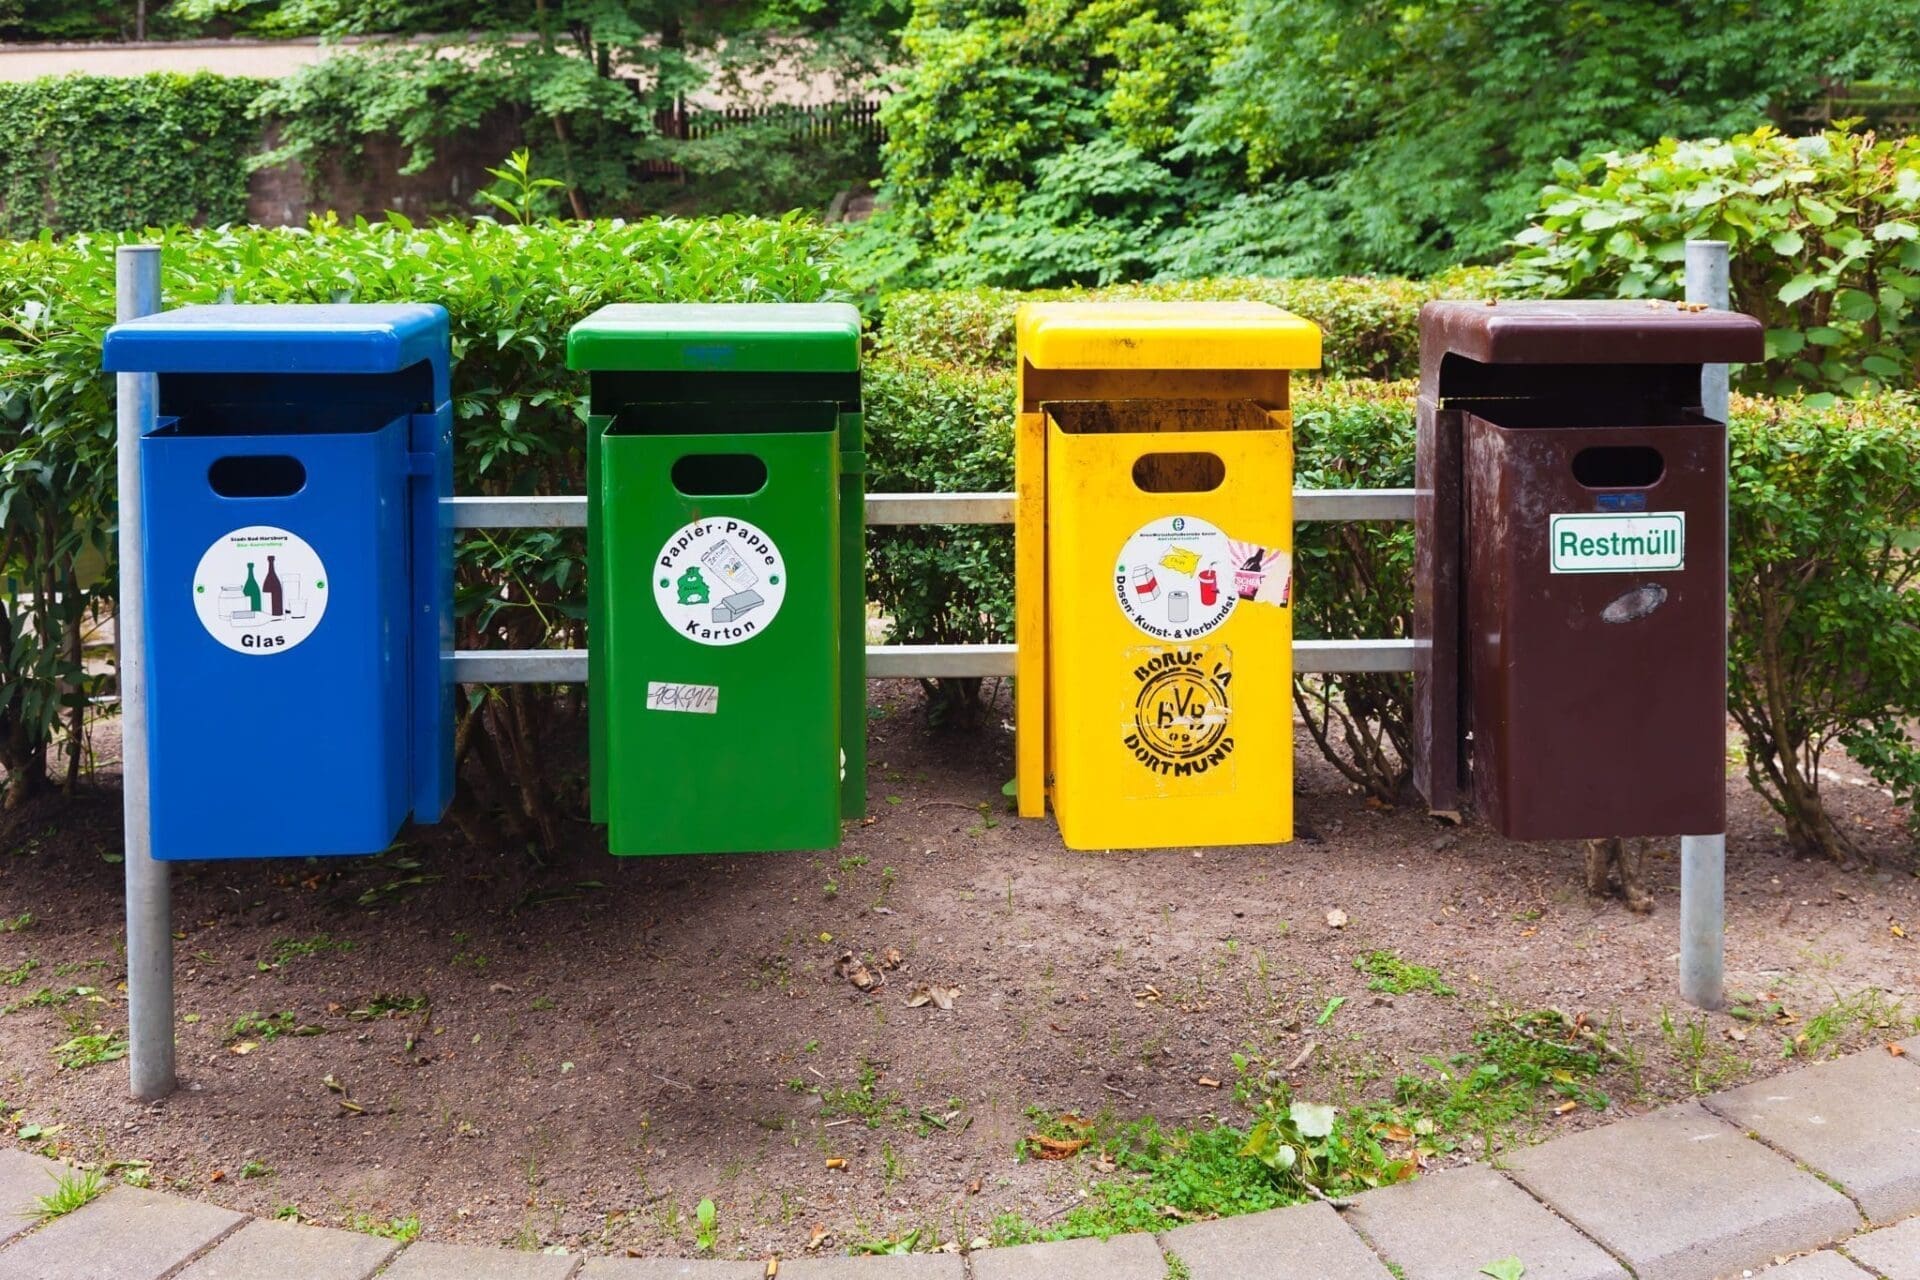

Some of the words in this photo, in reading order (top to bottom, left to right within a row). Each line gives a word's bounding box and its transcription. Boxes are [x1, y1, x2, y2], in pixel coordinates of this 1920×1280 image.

[661, 524, 713, 568] Papier
[726, 521, 775, 566] Pappe
[1560, 529, 1676, 556] Restmüll
[686, 620, 756, 640] Karton
[1134, 614, 1172, 638] Kunst-
[1174, 630, 1182, 638] &
[241, 634, 286, 648] Glas
[1124, 733, 1234, 776] DORTMUND
